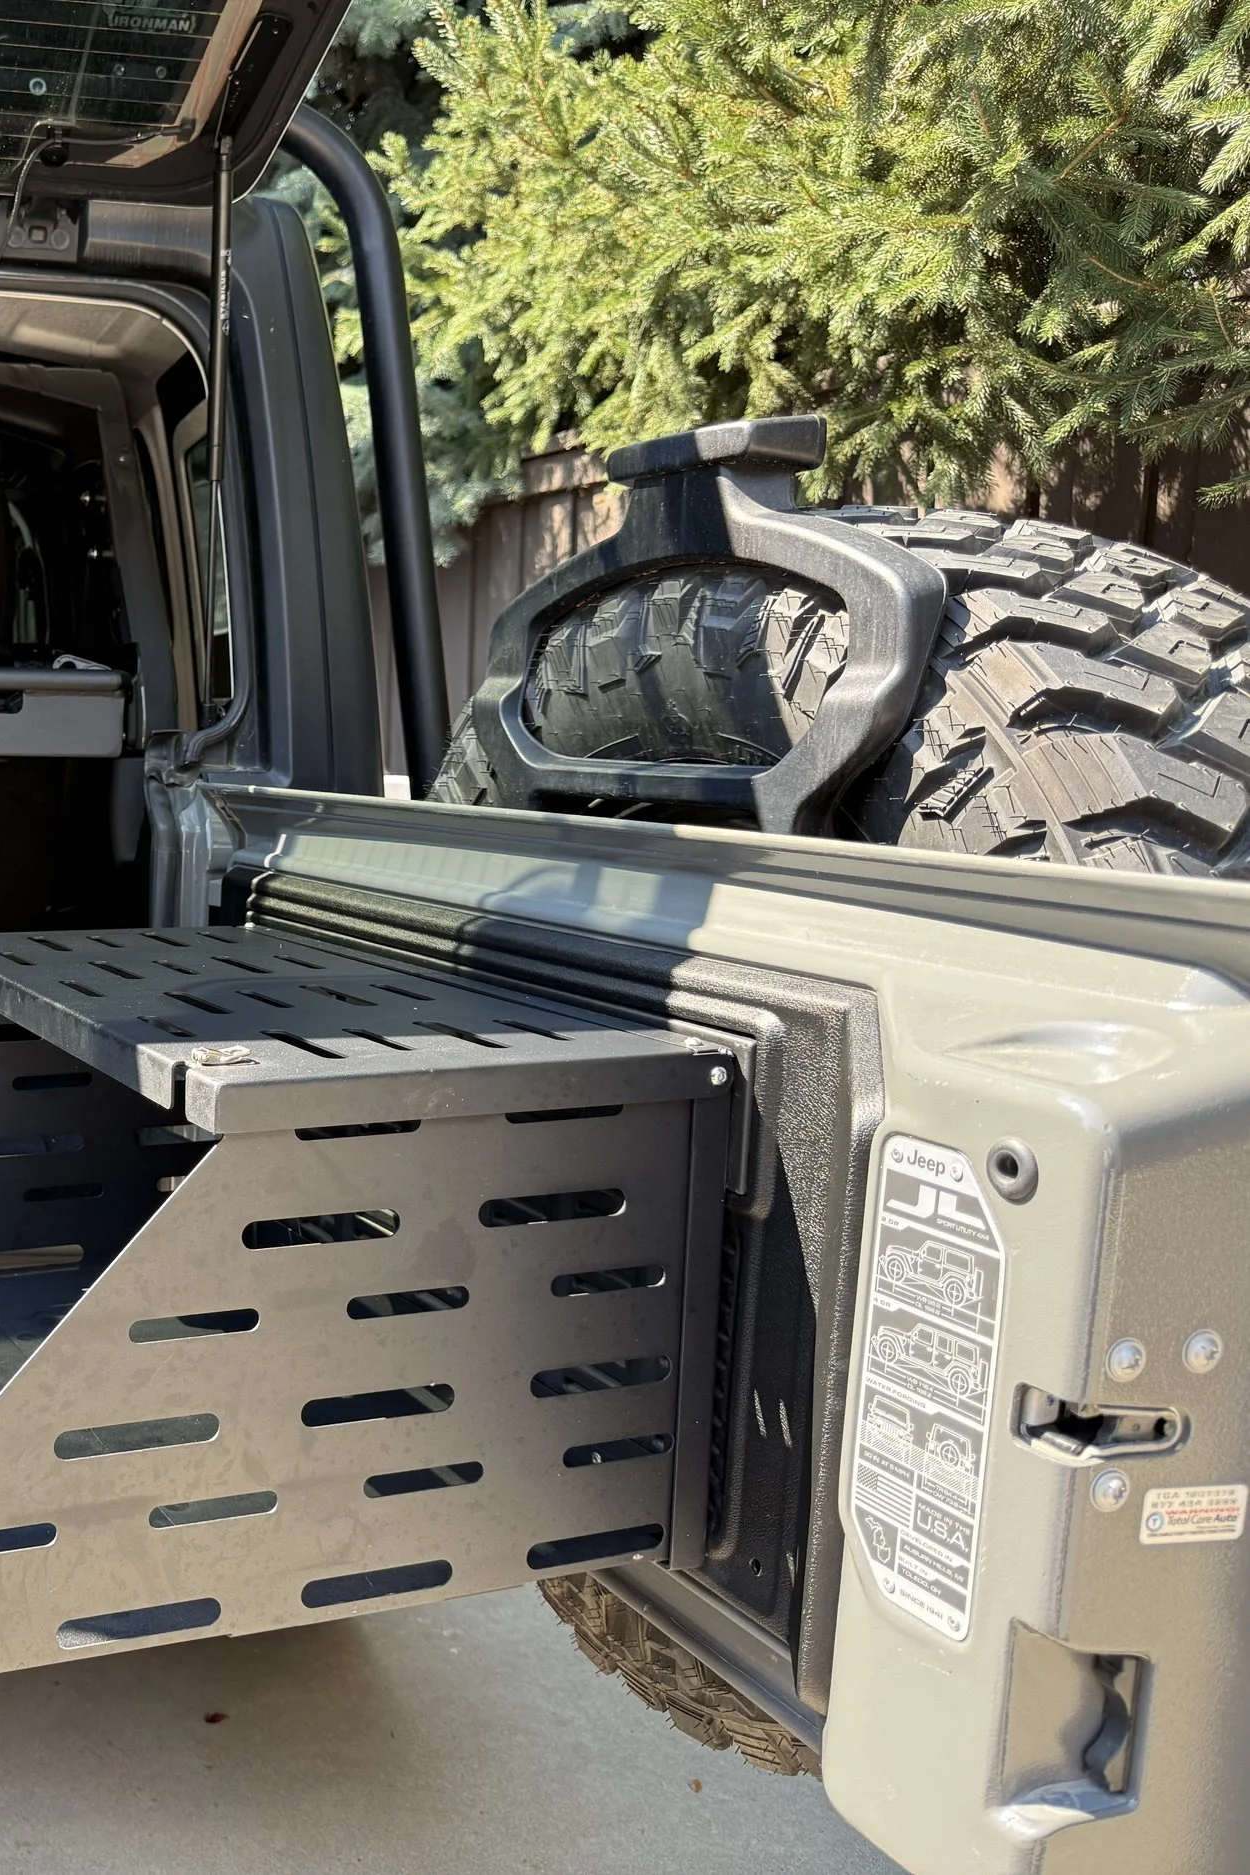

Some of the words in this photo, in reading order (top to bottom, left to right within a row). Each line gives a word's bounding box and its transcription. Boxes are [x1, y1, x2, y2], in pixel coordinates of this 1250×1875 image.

[114, 15, 190, 31] IRONMAN
[907, 1149, 946, 1177] Jeep
[886, 1184, 986, 1231] JL
[866, 1376, 891, 1391] WATER
[892, 1389, 926, 1409] FORDING
[918, 1502, 942, 1520] MADE
[943, 1516, 953, 1526] IN
[954, 1522, 971, 1535] THE
[1167, 1514, 1190, 1526] Total
[1191, 1514, 1213, 1525] Care
[1213, 1513, 1238, 1523] Auto
[900, 1529, 943, 1557] DEVELOPED
[944, 1554, 953, 1562] IN
[903, 1544, 933, 1565] AUBURN
[898, 1555, 919, 1570] BUILT
[919, 1567, 928, 1576] IN
[899, 1588, 925, 1609] SINCE
[926, 1604, 943, 1620] 1941
